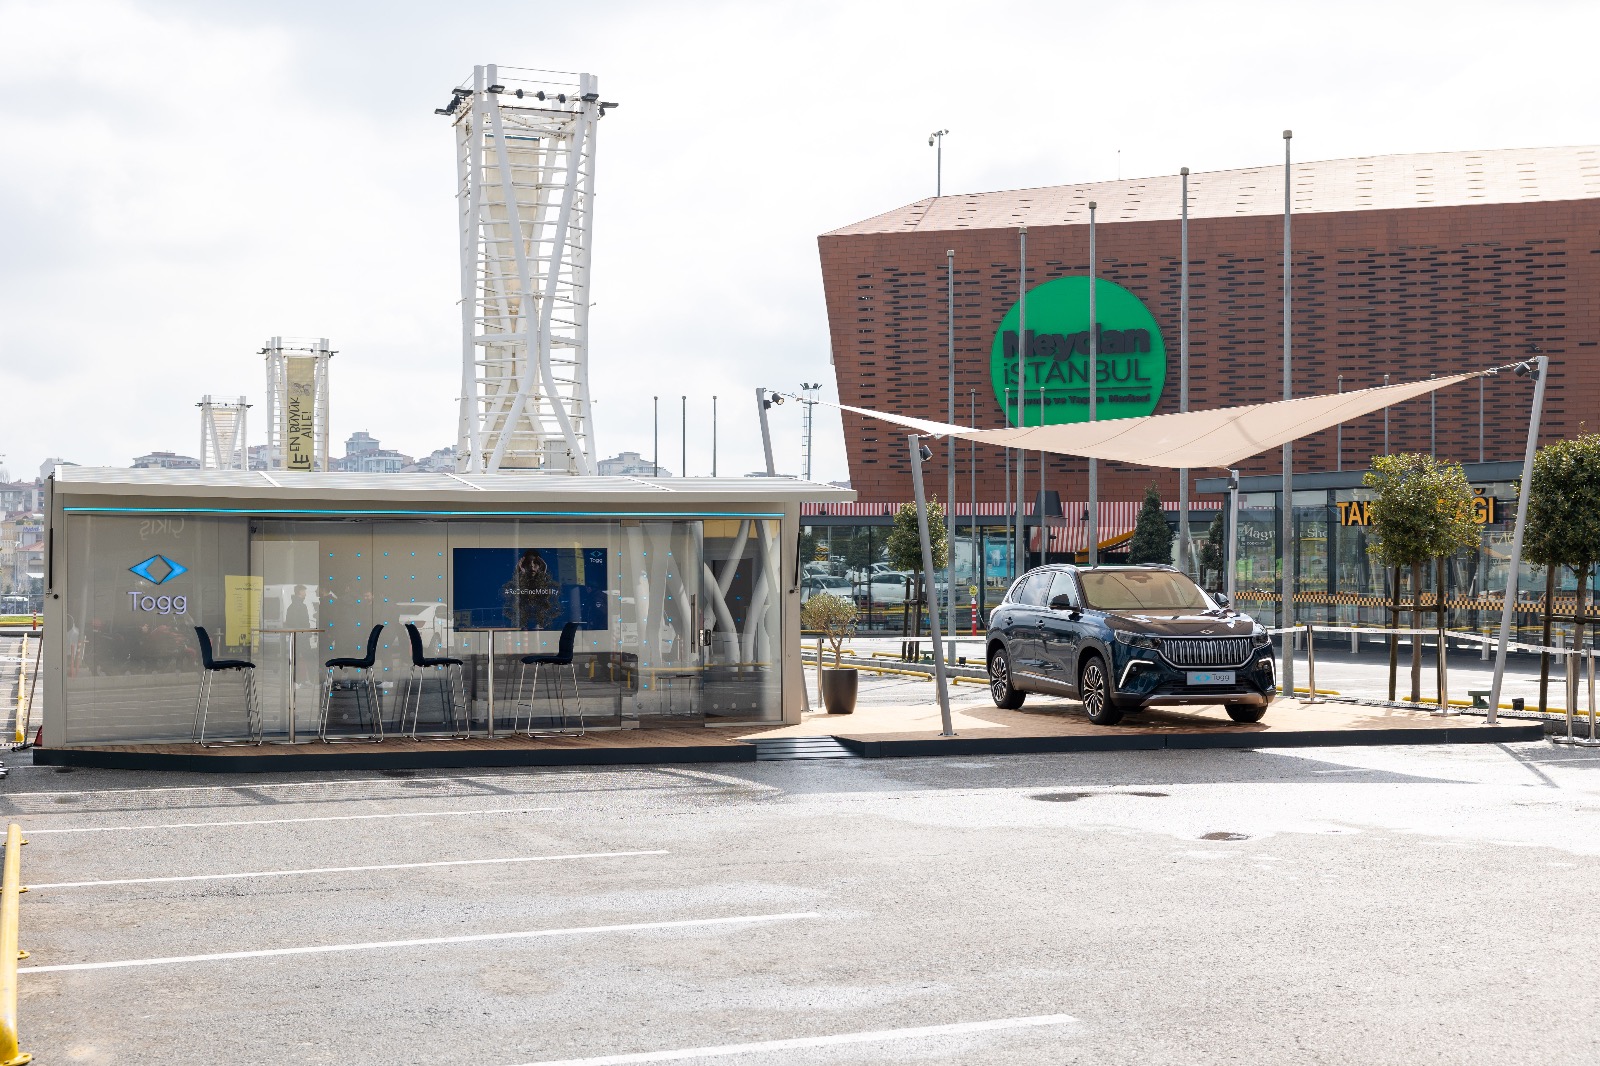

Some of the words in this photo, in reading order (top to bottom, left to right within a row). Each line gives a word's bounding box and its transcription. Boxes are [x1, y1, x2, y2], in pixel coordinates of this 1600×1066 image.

[1002, 323, 1151, 362] Meydan
[289, 396, 301, 433] BÜYÜK
[289, 436, 301, 452] EN
[288, 453, 311, 472] LE
[1336, 500, 1376, 526] TAK
[126, 591, 187, 615] Togg
[1212, 673, 1230, 682] Togg
